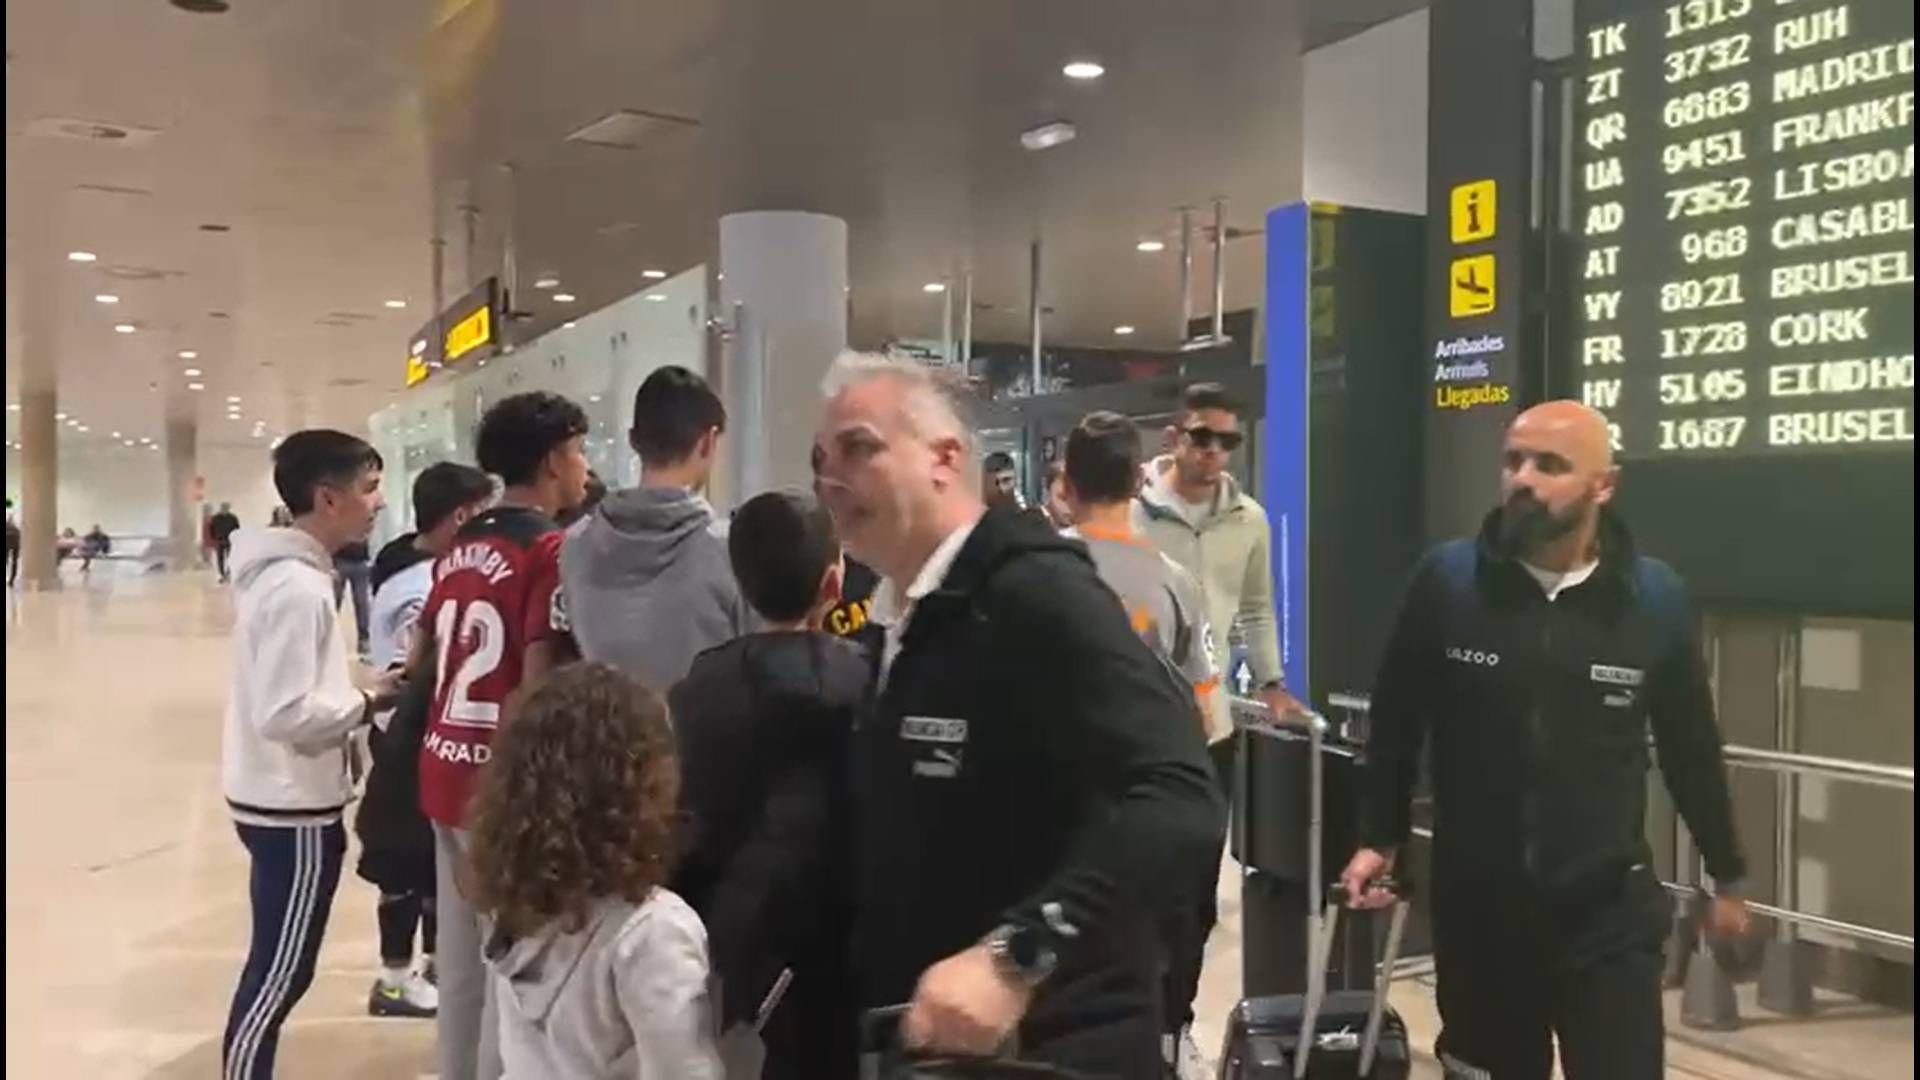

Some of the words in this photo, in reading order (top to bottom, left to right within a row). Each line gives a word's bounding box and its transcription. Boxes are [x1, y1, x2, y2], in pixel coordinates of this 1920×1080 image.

[1586, 68, 1624, 104] ZT
[1664, 34, 1751, 83] 3732
[1774, 6, 1848, 54] RUH
[1587, 23, 1627, 60] TK
[1585, 158, 1624, 191] UA
[1664, 130, 1746, 174] 9451
[1773, 91, 1914, 152] FRANKF
[1587, 113, 1627, 149] QR
[1585, 202, 1624, 235] AD
[1585, 247, 1620, 278] AT
[1681, 225, 1747, 263] 968
[1771, 198, 1914, 249] CASABL
[1585, 291, 1621, 321] VY
[1661, 274, 1745, 312] 8921
[1770, 251, 1914, 298] BRUSEL
[1583, 335, 1625, 365] FR
[1660, 321, 1747, 358] 1728
[1770, 307, 1869, 346] CORK
[1436, 383, 1510, 410] Llegadas
[1583, 379, 1622, 408] HV
[1659, 369, 1747, 404] 5105
[1768, 408, 1914, 445] BRUSEL
[434, 599, 505, 729] 12
